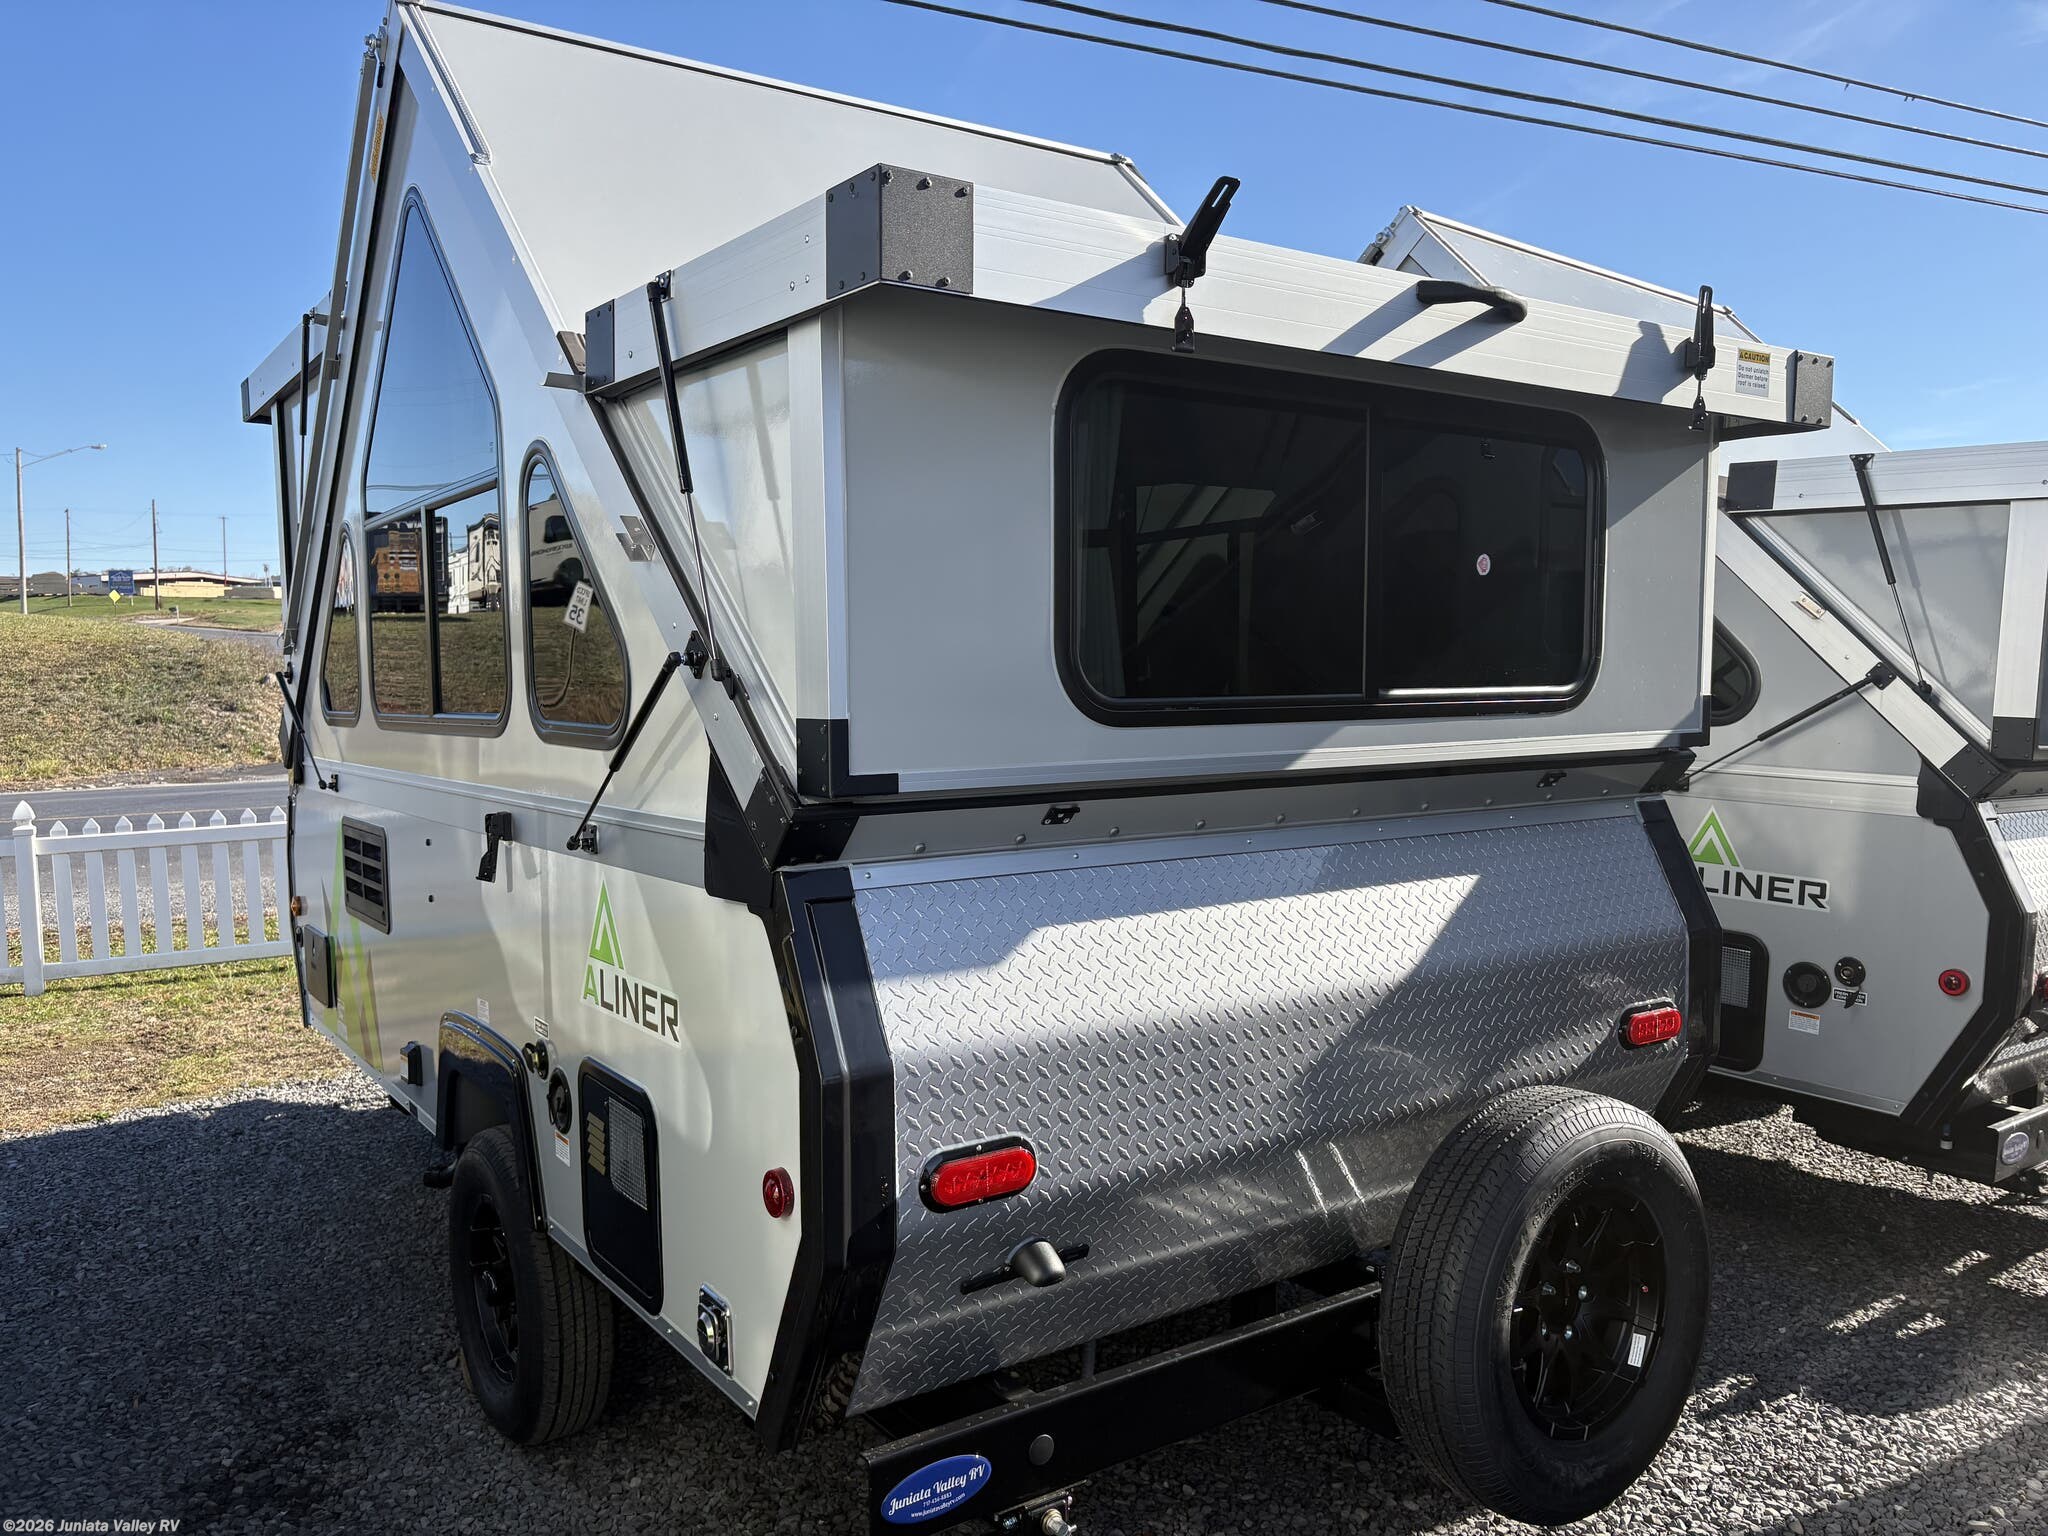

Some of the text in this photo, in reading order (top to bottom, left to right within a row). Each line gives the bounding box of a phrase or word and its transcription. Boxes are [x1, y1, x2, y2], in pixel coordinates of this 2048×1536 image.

[1743, 352, 1770, 363] CAUTION
[1754, 374, 1768, 382] before
[1697, 866, 1828, 909] LINER
[583, 963, 680, 1043] ALINER
[888, 1463, 986, 1516] Juniata Valley RV
